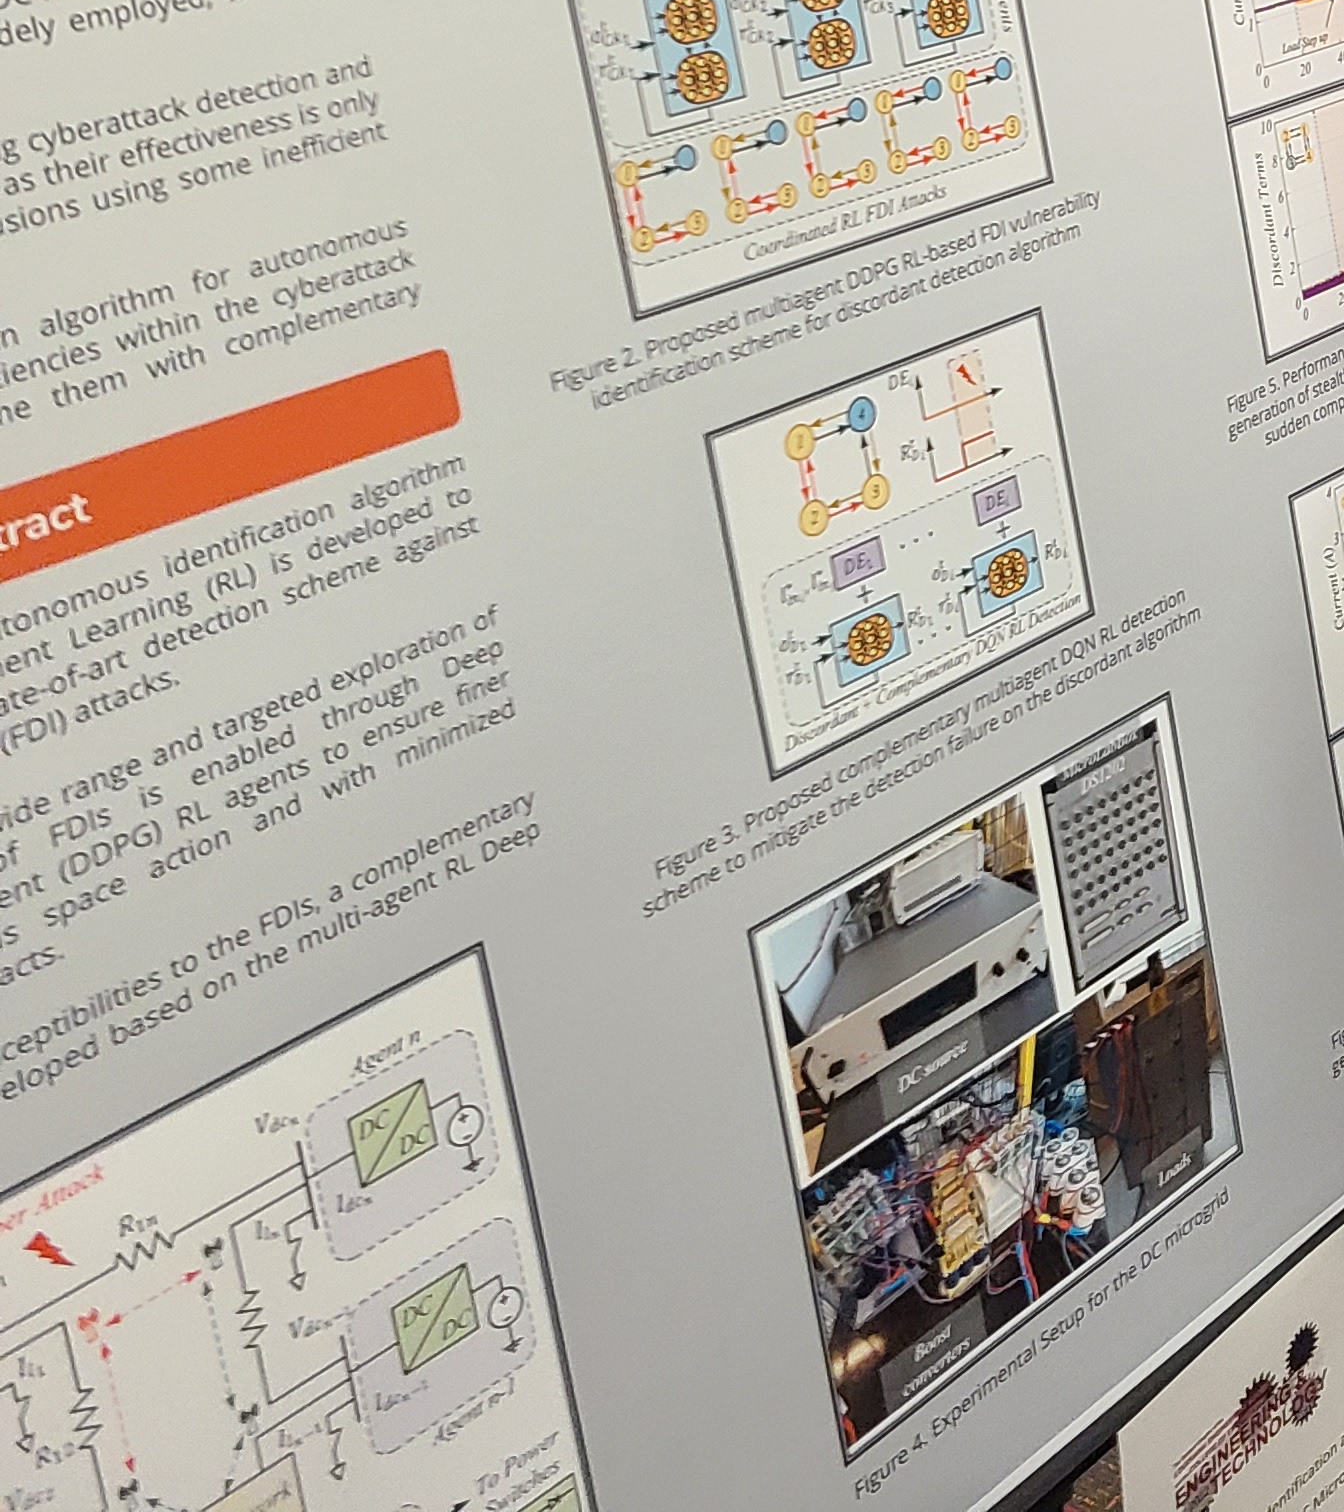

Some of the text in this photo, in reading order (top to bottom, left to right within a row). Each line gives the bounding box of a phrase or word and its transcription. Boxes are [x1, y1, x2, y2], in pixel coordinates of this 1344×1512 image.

[27, 55, 374, 158] cyberattack detection and
[44, 91, 381, 188] their effectiveness is only
[41, 218, 409, 338] algorithm for autonomous
[549, 359, 618, 391] Figure
[646, 312, 740, 359] Proposed
[744, 275, 845, 327] multiagent
[846, 258, 899, 289] DDPG
[902, 230, 977, 274] RL-based
[979, 220, 1007, 244] FDI
[1009, 189, 1101, 236] vulnerability
[52, 283, 421, 408] them with complementary
[1227, 387, 1266, 413] Figure
[164, 455, 466, 579] identification algorithm
[854, 1453, 909, 1499] Figure
[931, 1354, 1037, 1440] Experimental
[1040, 1307, 1086, 1354] Setup
[1088, 1286, 1111, 1316] for
[1113, 1268, 1138, 1298] the
[1141, 1252, 1163, 1277] DC
[1165, 1187, 1230, 1256] microgrid
[1175, 1386, 1291, 1510] ENGINEERING
